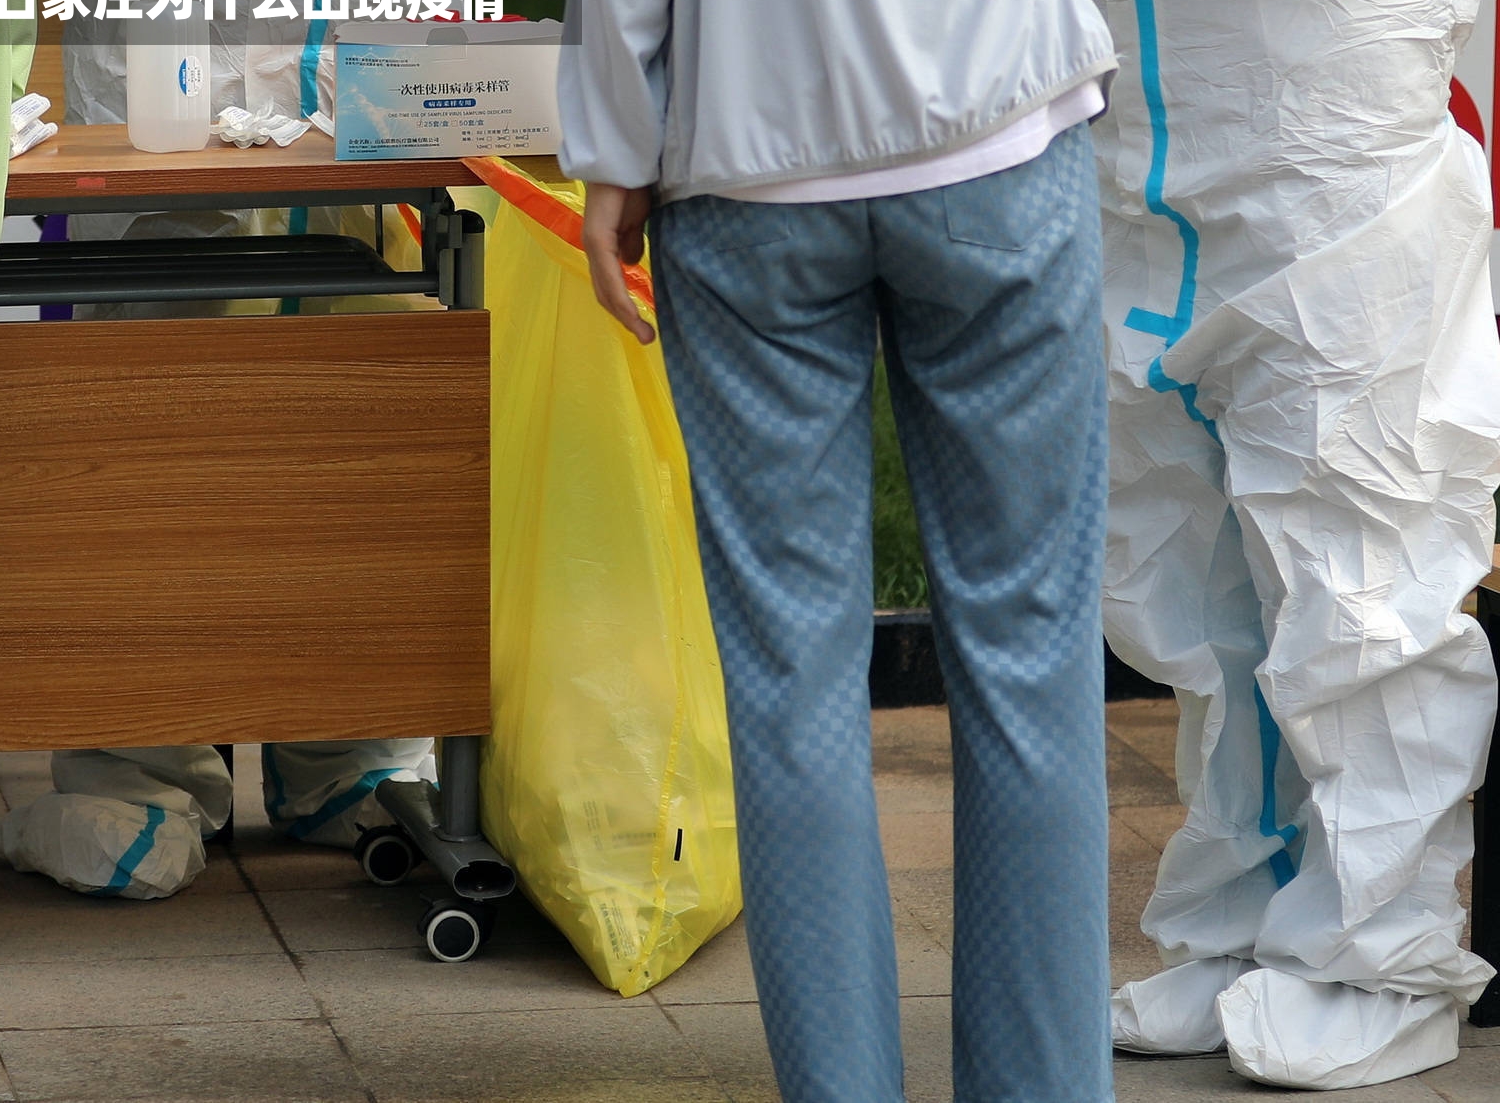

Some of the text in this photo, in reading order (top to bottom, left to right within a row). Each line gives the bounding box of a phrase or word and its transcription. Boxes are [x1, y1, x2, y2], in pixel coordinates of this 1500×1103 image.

[388, 80, 510, 96] 一次性使用病毒采样管
